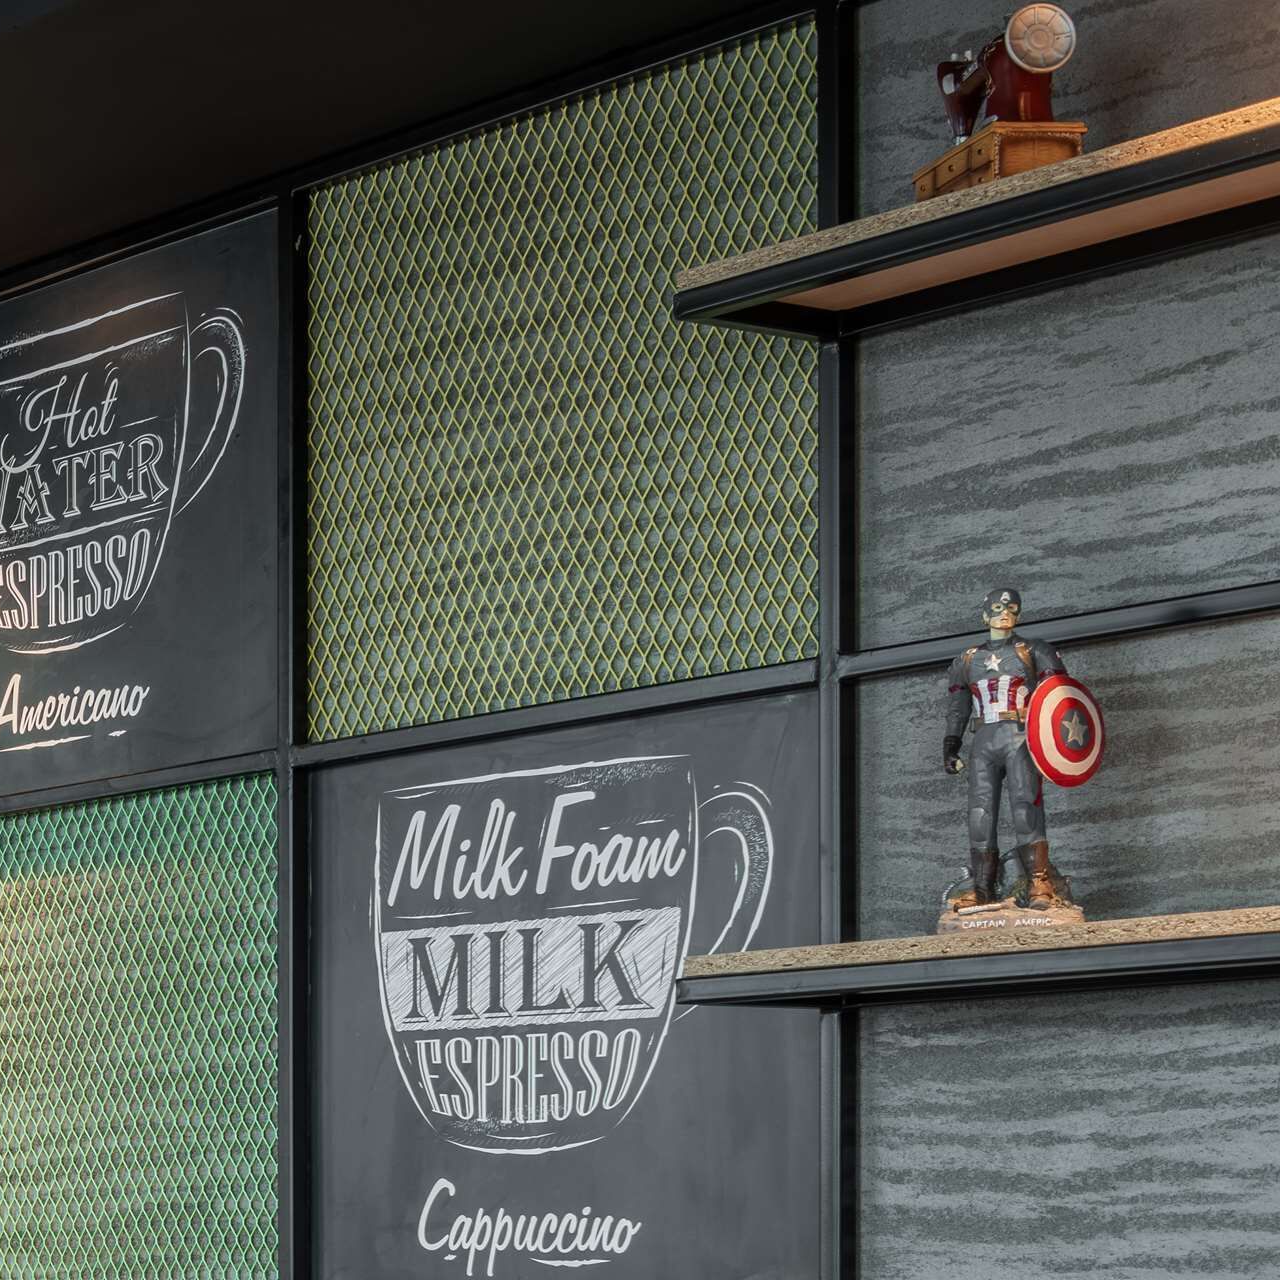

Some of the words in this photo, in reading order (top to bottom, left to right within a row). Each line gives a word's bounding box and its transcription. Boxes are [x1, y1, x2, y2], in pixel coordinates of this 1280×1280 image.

[0, 373, 120, 473] Hot
[388, 798, 528, 907] Milk
[535, 791, 686, 895] Foam
[404, 918, 657, 1026] MILK
[961, 919, 1006, 929] CAPTAIN
[415, 1028, 641, 1124] ESPRESSO
[417, 1178, 642, 1276] Cappuccino
